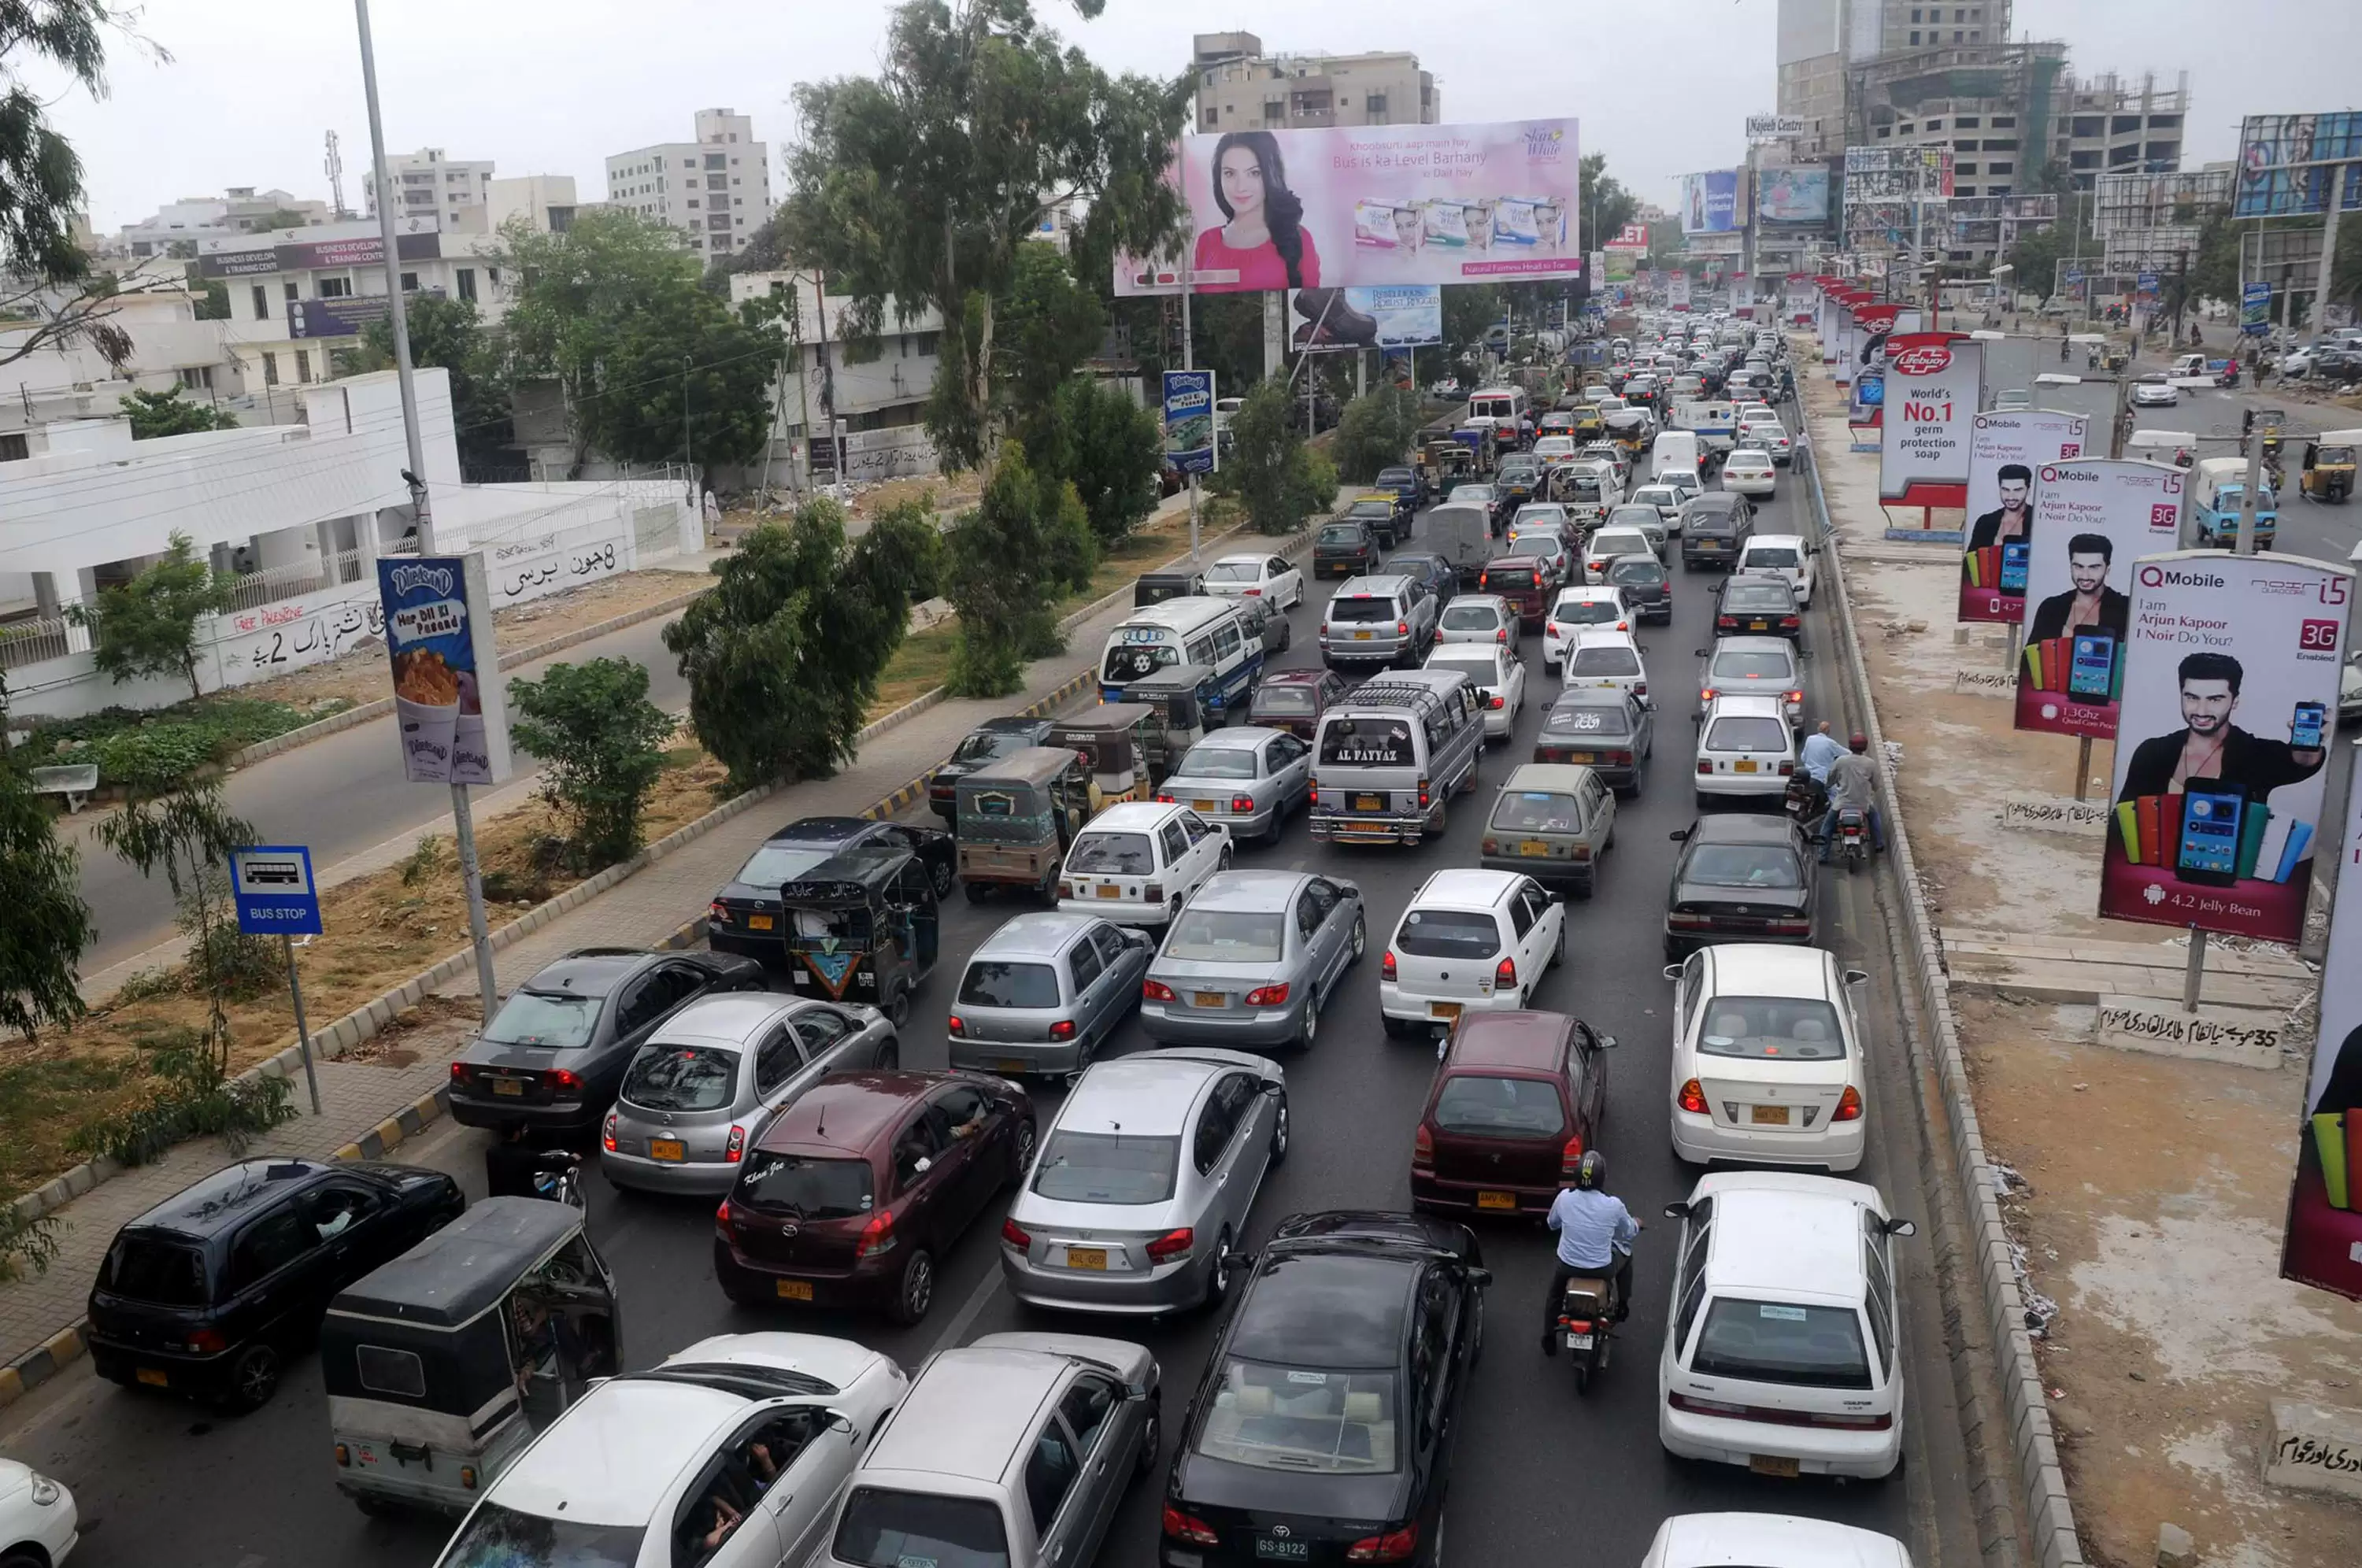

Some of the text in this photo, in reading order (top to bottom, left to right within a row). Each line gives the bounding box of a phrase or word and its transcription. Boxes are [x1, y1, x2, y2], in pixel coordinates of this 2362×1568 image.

[1426, 139, 1450, 150] main
[1333, 156, 1357, 169] Bus
[1362, 155, 1372, 168] is
[1375, 153, 1391, 167] ka
[1395, 153, 1428, 166] Level
[362, 251, 384, 262] CENTR
[1899, 354, 1948, 367] Lifebuoy
[1911, 388, 1951, 399] World's
[1904, 401, 1952, 422] No.1
[1915, 426, 1943, 436] germ
[1901, 438, 1956, 449] protection
[1915, 450, 1941, 460] soap
[2045, 491, 2060, 500] am
[2040, 500, 2103, 513] Arjun Kapoor
[2045, 512, 2066, 521] Noir
[2153, 508, 2175, 523] 3G
[604, 543, 616, 570] 8
[2146, 601, 2166, 611] am
[2138, 613, 2228, 631] Arjun Kapoor
[2145, 629, 2175, 641] Noir
[2177, 631, 2199, 644] Do
[2202, 632, 2234, 647] You?
[2302, 624, 2335, 645] 3G
[2297, 653, 2336, 662] Enabled
[1337, 749, 1398, 761] AL FAYYAZ
[2171, 893, 2262, 918] 4.2 Jelly Bean
[250, 908, 306, 919] BUS STOP
[2253, 1029, 2279, 1048] 35
